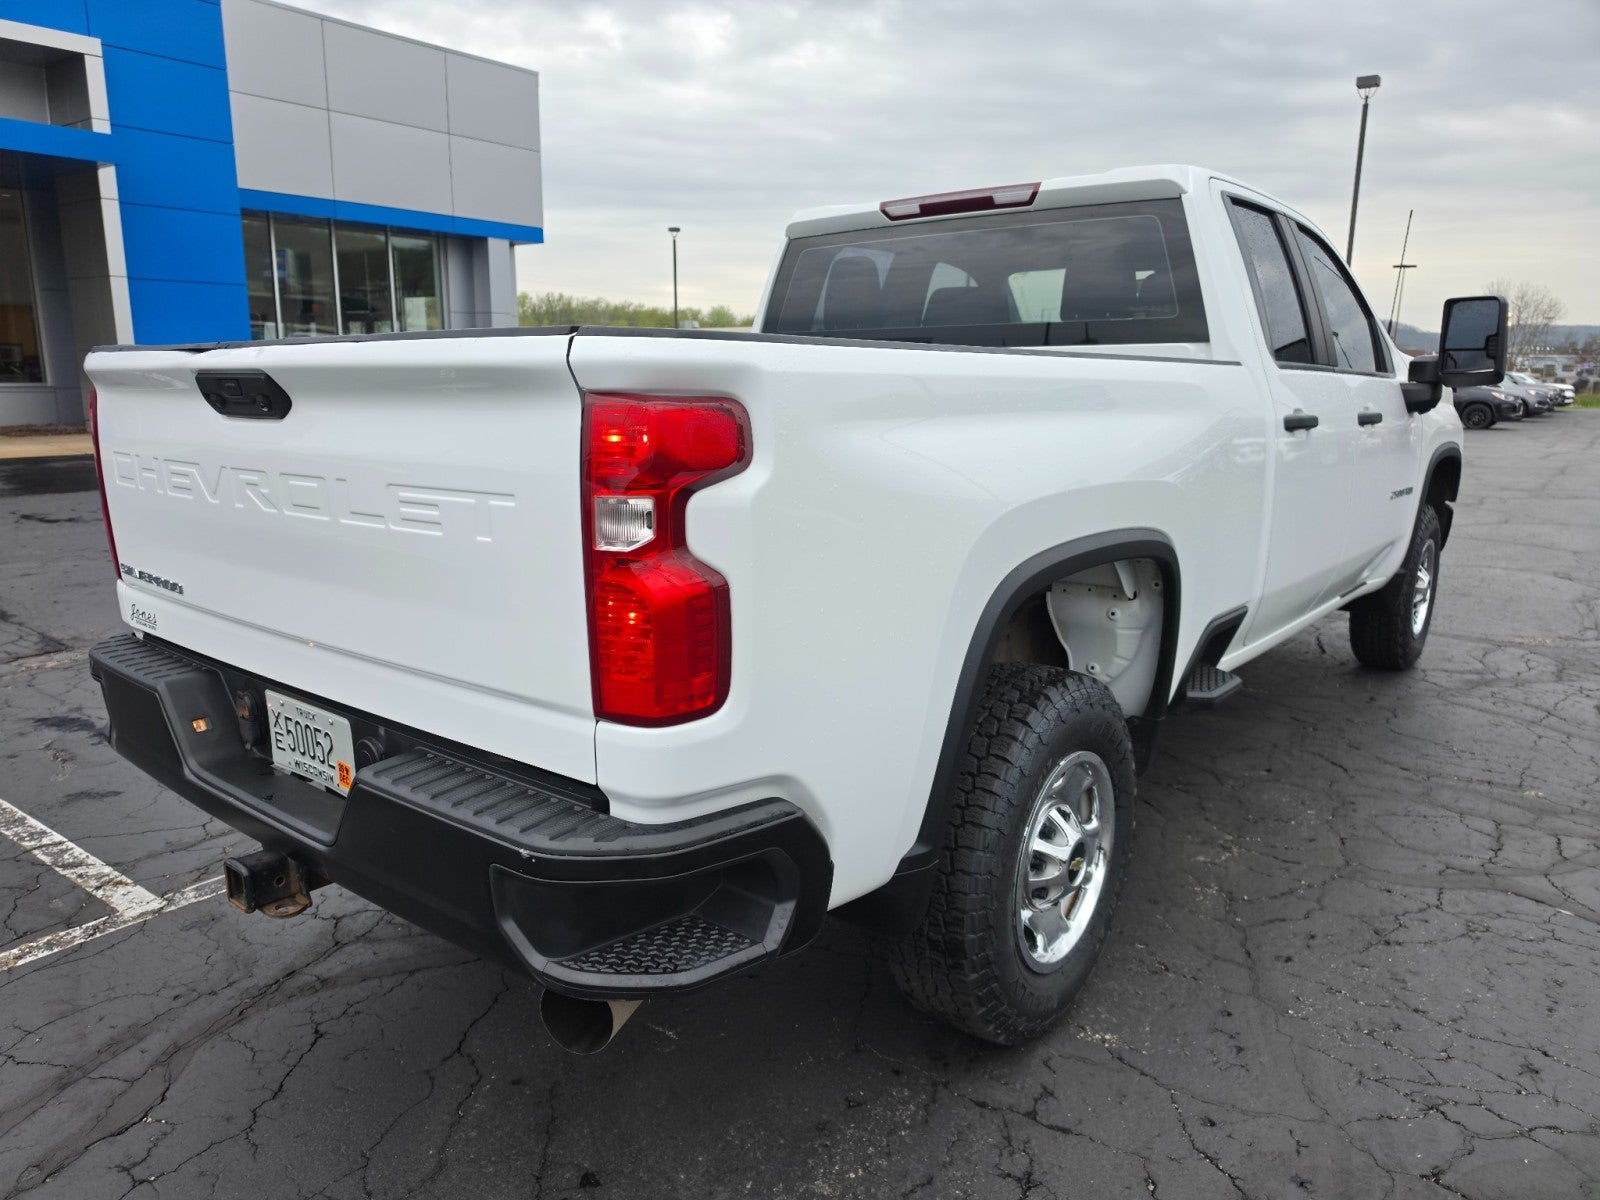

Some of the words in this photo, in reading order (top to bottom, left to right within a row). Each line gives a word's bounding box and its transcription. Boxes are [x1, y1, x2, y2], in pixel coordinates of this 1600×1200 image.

[112, 450, 516, 542] CHEVROLET
[130, 603, 157, 624] Jones
[295, 706, 317, 721] TRUCK
[284, 715, 336, 770] 50052
[293, 758, 334, 783] WISCONSIN
